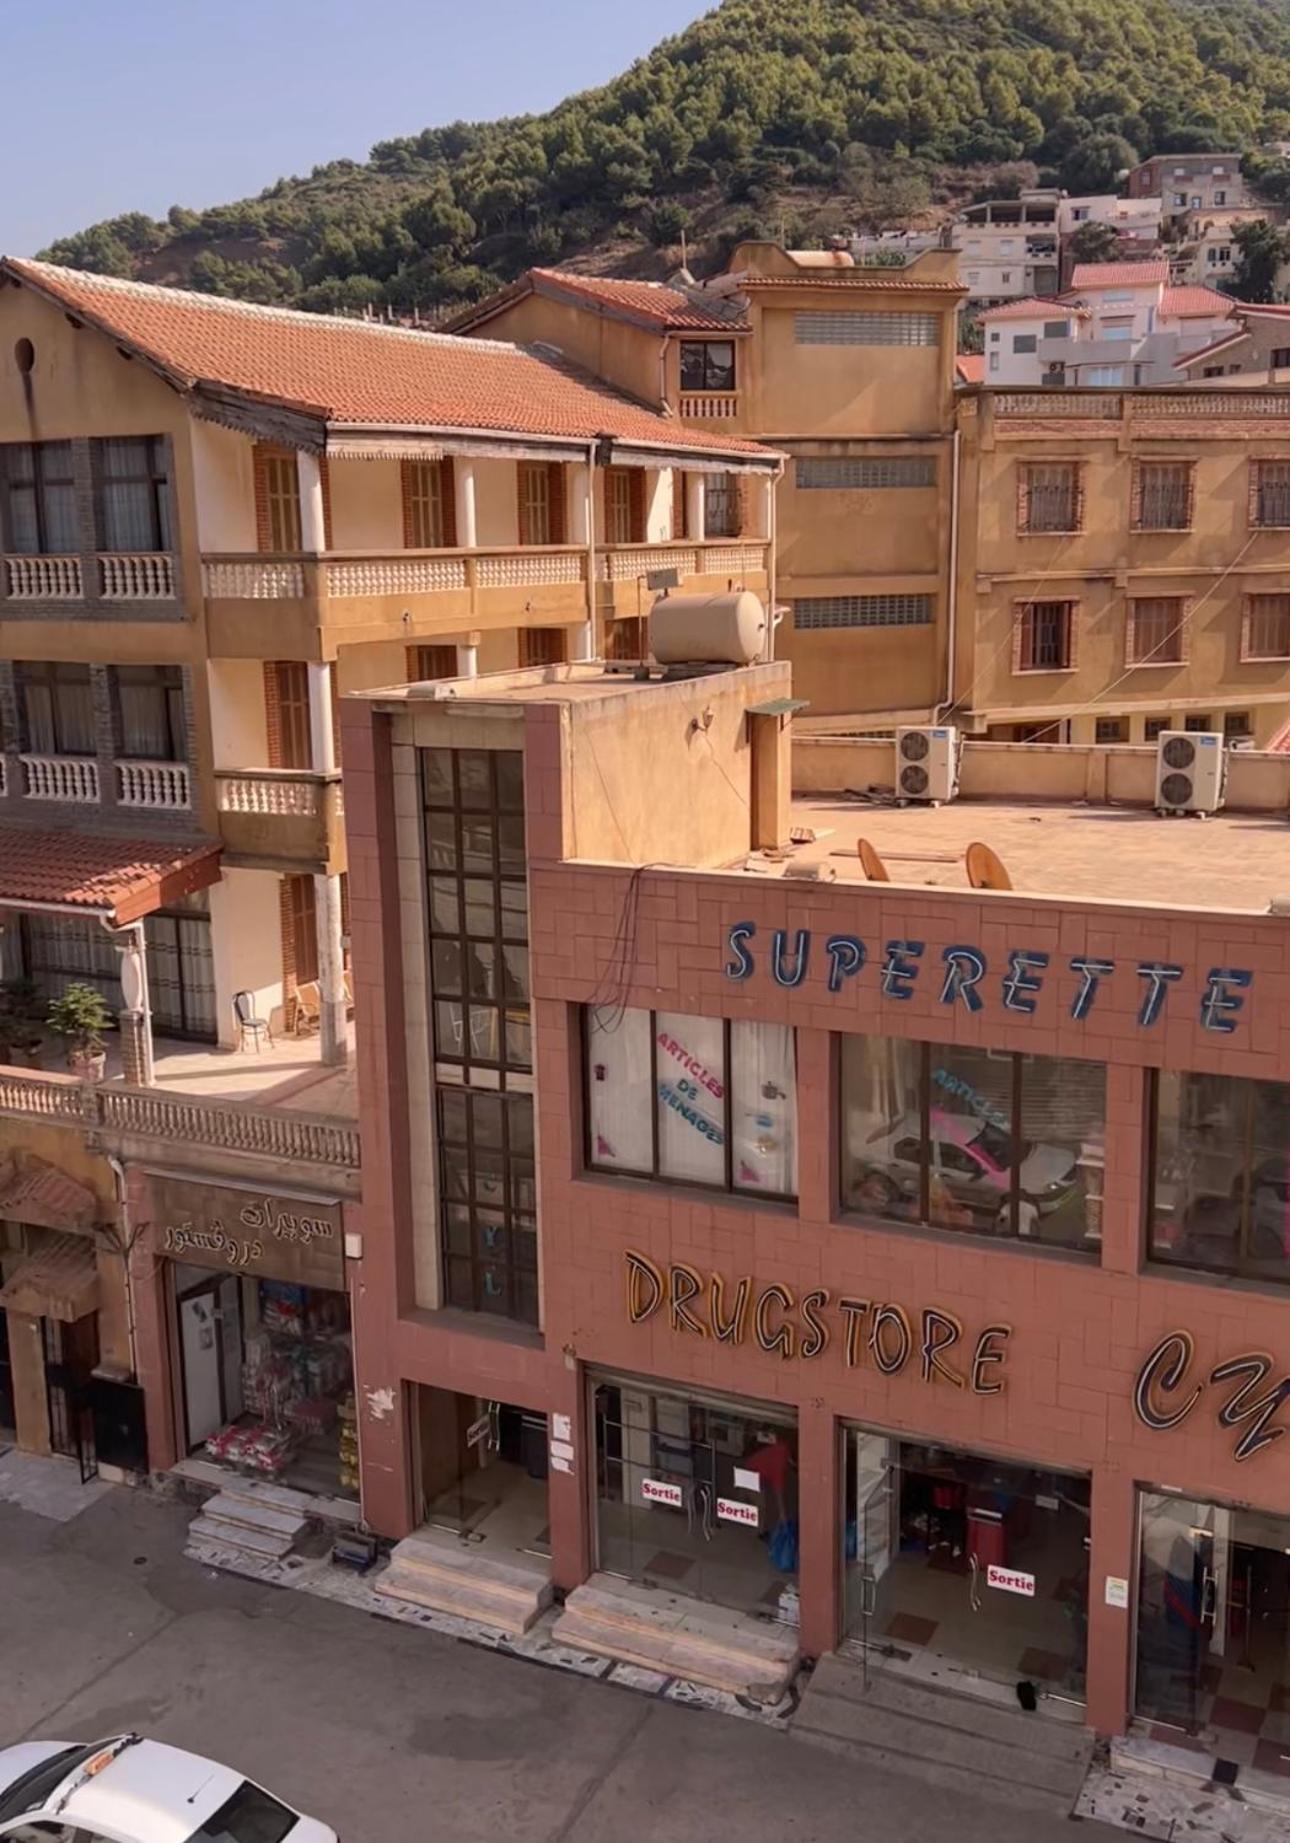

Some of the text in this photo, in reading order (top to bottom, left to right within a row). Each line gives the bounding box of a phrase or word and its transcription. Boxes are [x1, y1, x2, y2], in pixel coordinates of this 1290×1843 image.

[726, 920, 1252, 1034] SUPERETTE
[657, 1032, 725, 1099] ARTICLES
[677, 1078, 699, 1101] DE
[658, 1084, 725, 1146] MENAGES
[624, 1249, 1012, 1395] DRUGSTORE
[643, 1482, 681, 1502] Sortie
[717, 1501, 758, 1522] Sortie
[989, 1569, 1034, 1591] Sortie
